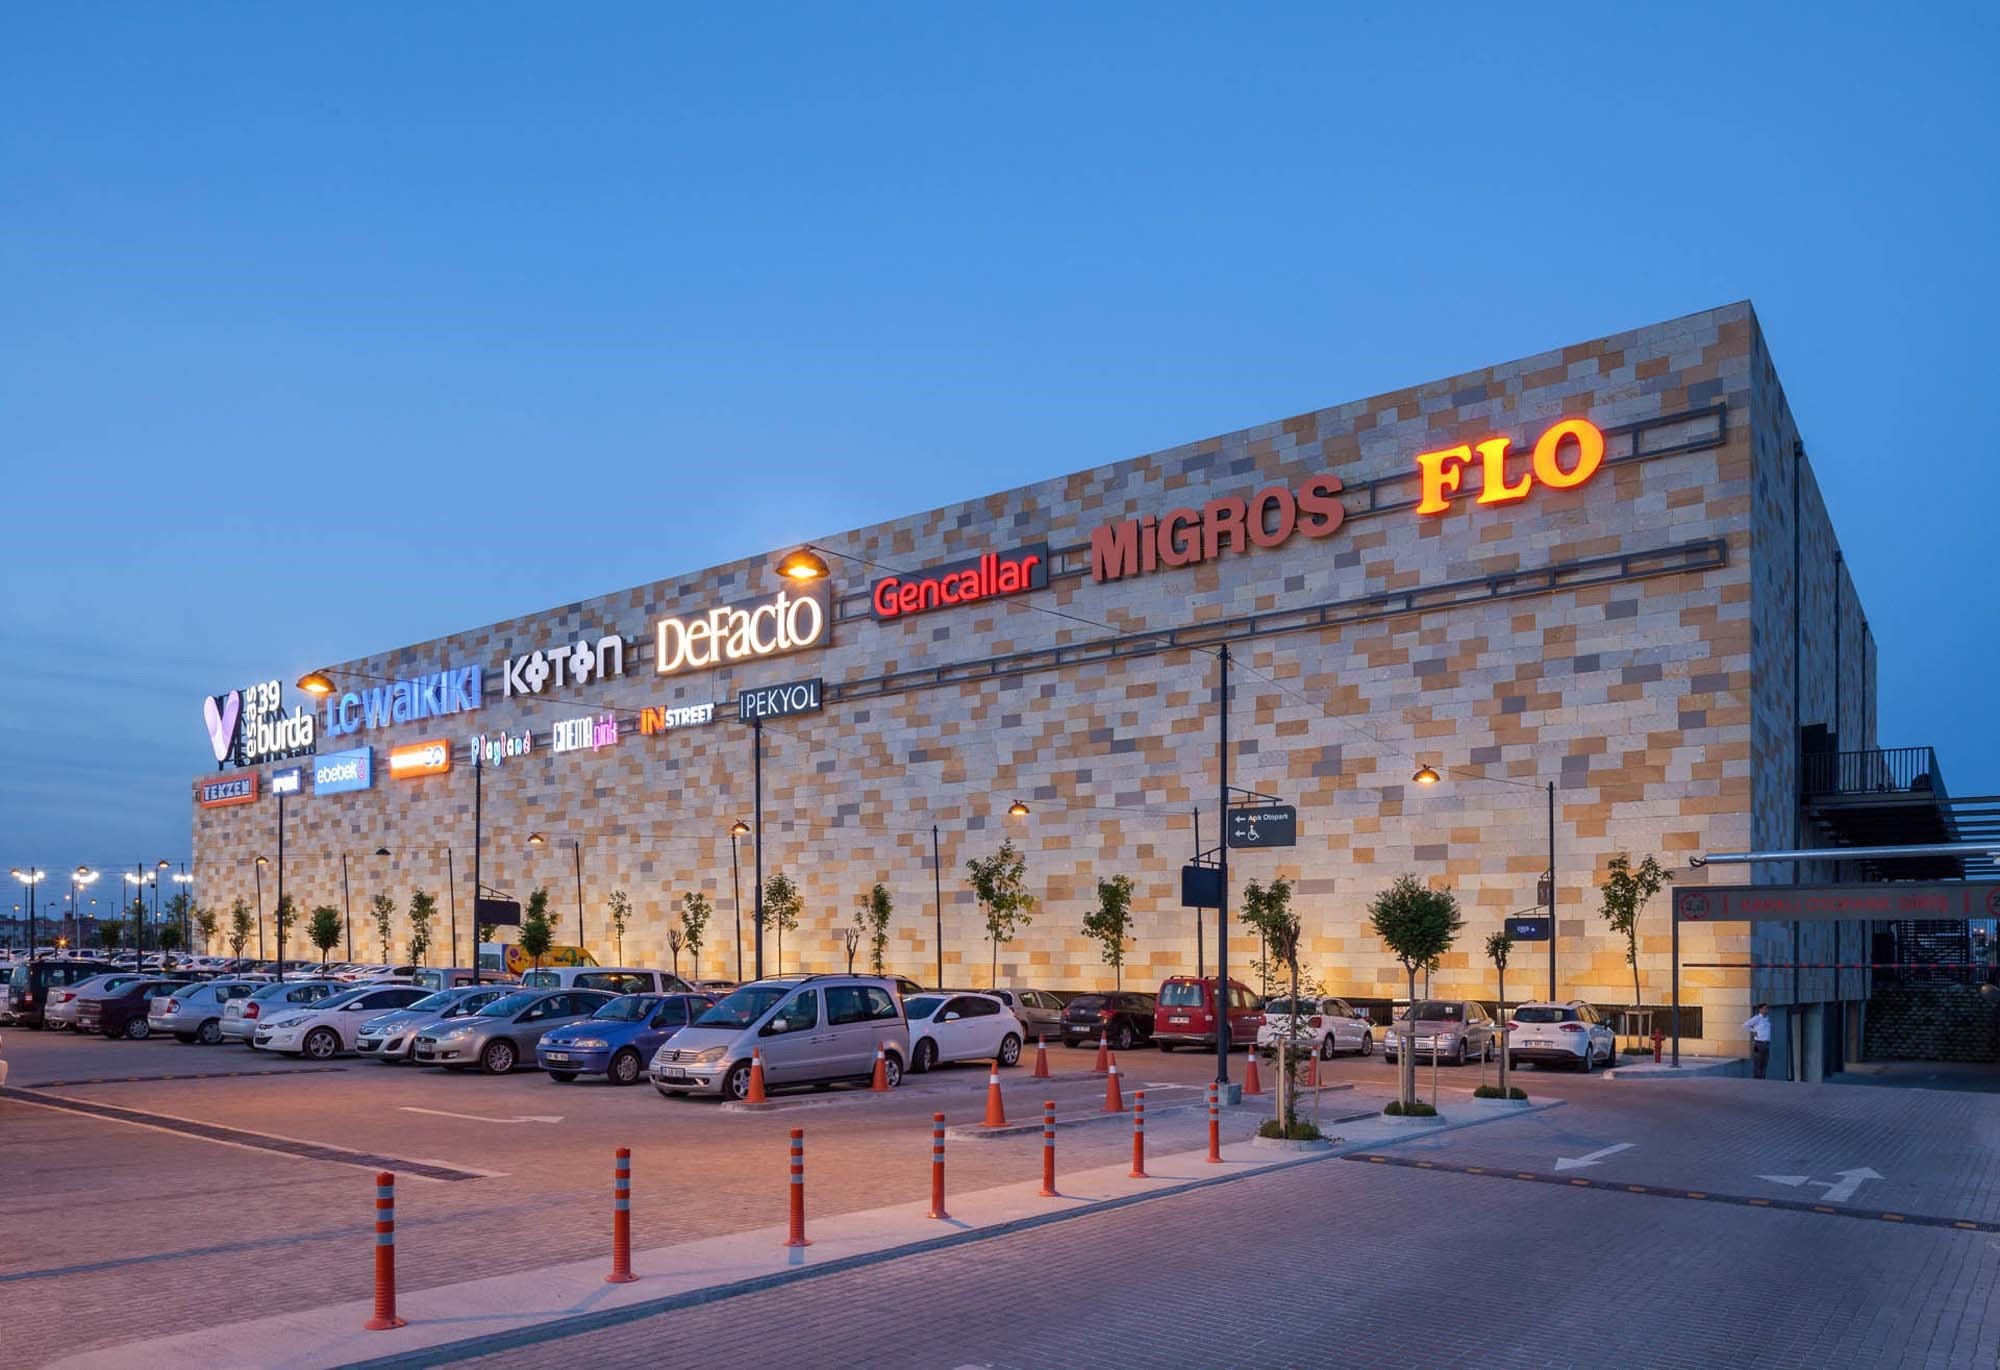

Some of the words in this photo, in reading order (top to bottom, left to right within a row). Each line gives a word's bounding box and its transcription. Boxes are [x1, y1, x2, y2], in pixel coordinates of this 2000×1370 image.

[1416, 418, 1604, 515] FLO
[874, 552, 1039, 616] Gencallar
[657, 591, 823, 673] DeFacto
[258, 679, 280, 713] 39
[257, 705, 313, 754] burda
[204, 780, 250, 801] TEKZEN
[317, 761, 357, 784] ebebek
